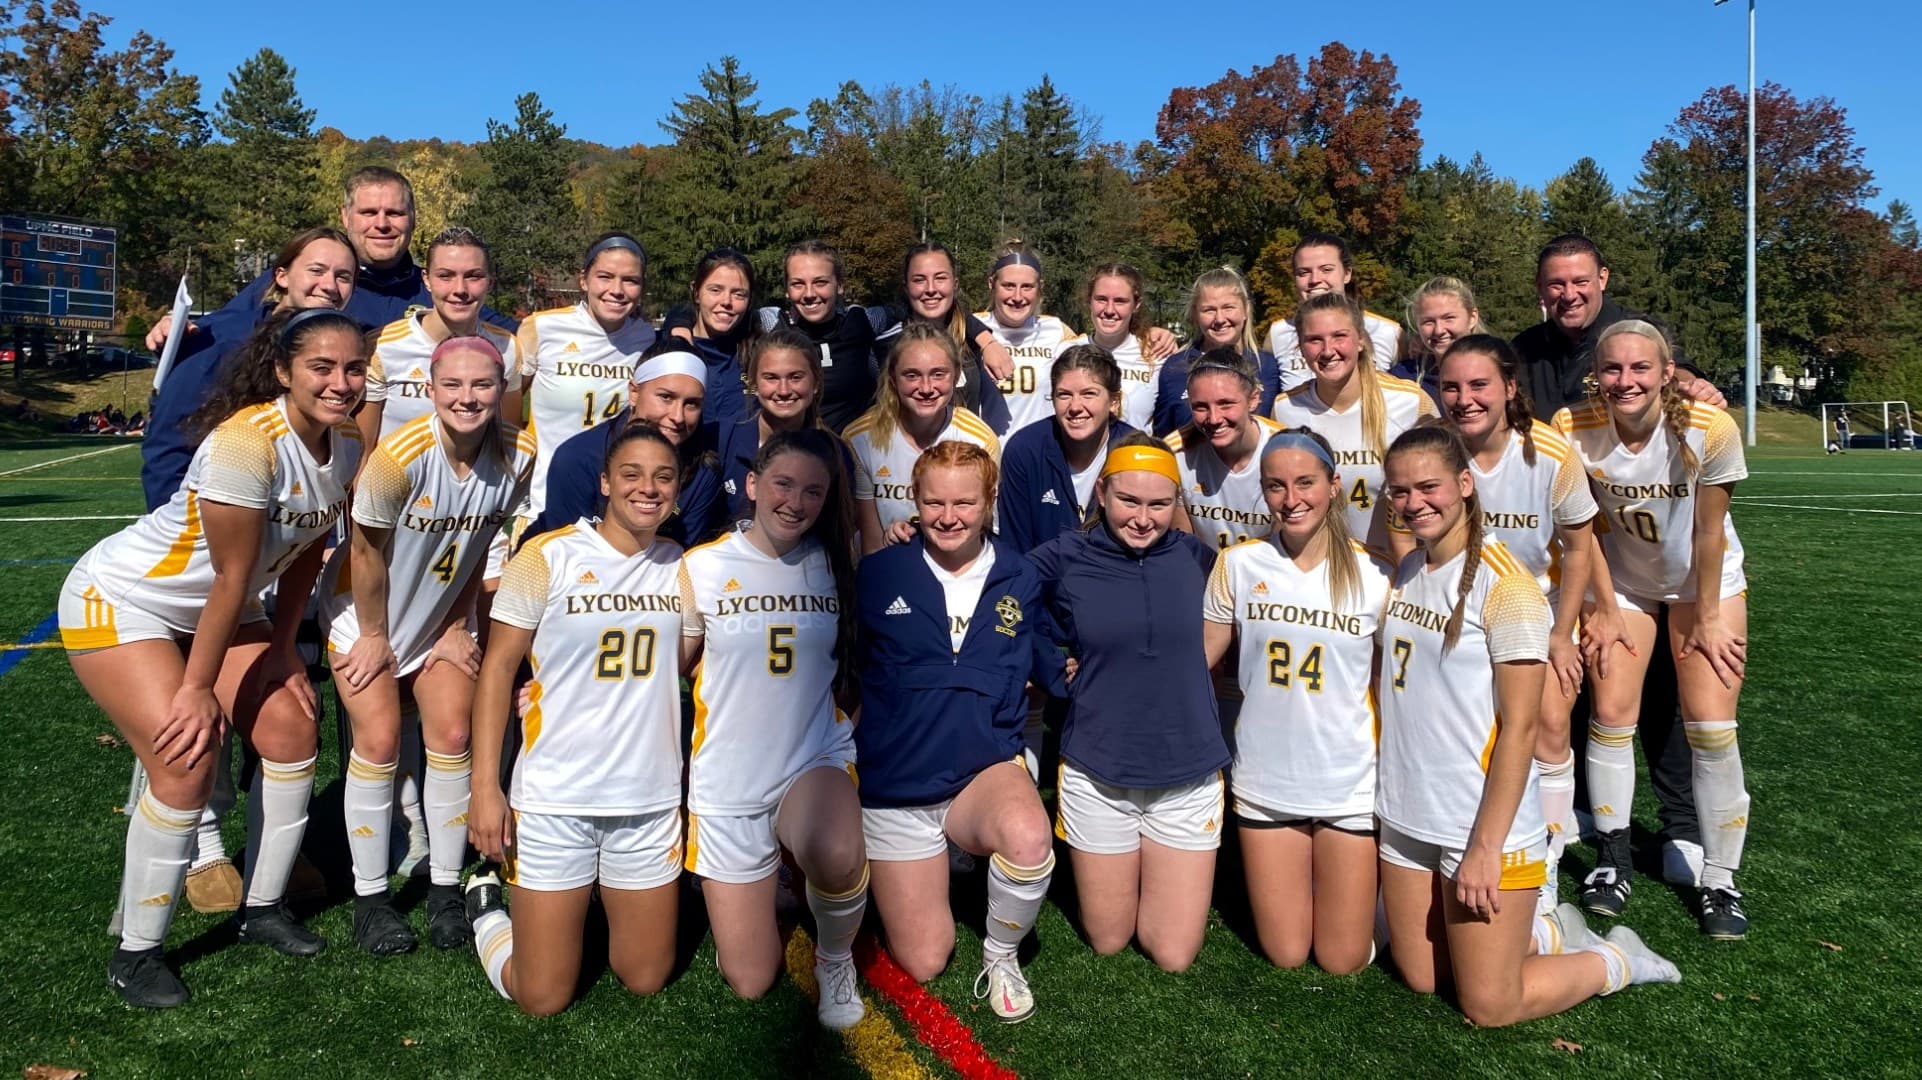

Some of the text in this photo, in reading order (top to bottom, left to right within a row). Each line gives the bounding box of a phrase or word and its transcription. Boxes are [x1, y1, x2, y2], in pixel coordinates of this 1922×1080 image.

[26, 221, 93, 238] UPMC FIELD
[58, 318, 110, 329] WARRIORS
[556, 362, 635, 380] LYCOMIN
[582, 389, 622, 429] 14
[1190, 504, 1273, 526] LYCOMIN
[1613, 505, 1660, 543] 10
[431, 542, 461, 584] 4
[565, 593, 681, 616] LYCOMING
[717, 594, 840, 616] LYCOMING
[885, 606, 912, 615] adidas
[1247, 602, 1361, 636] LYCOMING
[595, 627, 657, 680] 20
[767, 625, 796, 677] 5
[1266, 638, 1325, 693] 24
[1393, 636, 1412, 691] 7
